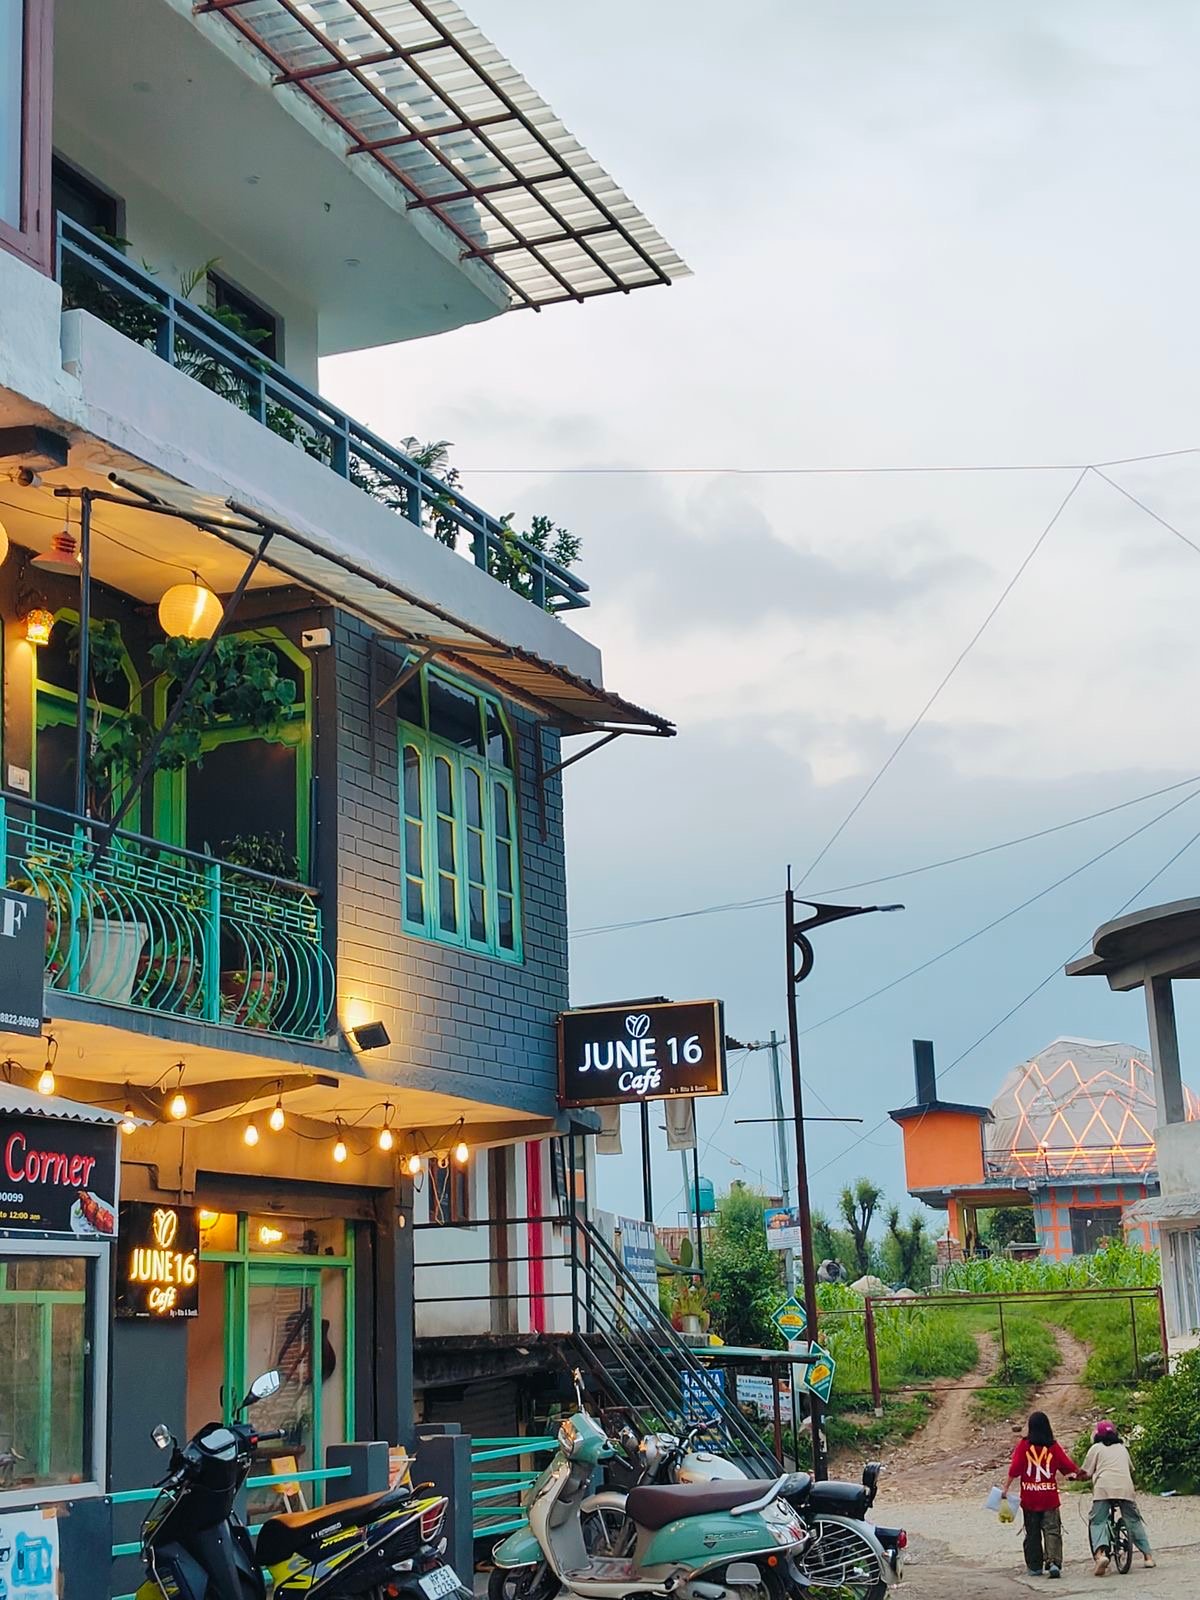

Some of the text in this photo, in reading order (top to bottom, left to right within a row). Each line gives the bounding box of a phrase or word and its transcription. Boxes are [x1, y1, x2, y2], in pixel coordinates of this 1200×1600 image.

[0, 897, 28, 938] F
[0, 1012, 40, 1028] 8822-99099
[578, 1035, 703, 1072] JUNE 16
[618, 1067, 662, 1095] Café
[4, 1131, 95, 1187] Corner
[9, 1211, 29, 1219] 12:00
[1021, 1481, 1056, 1491] YANKEES
